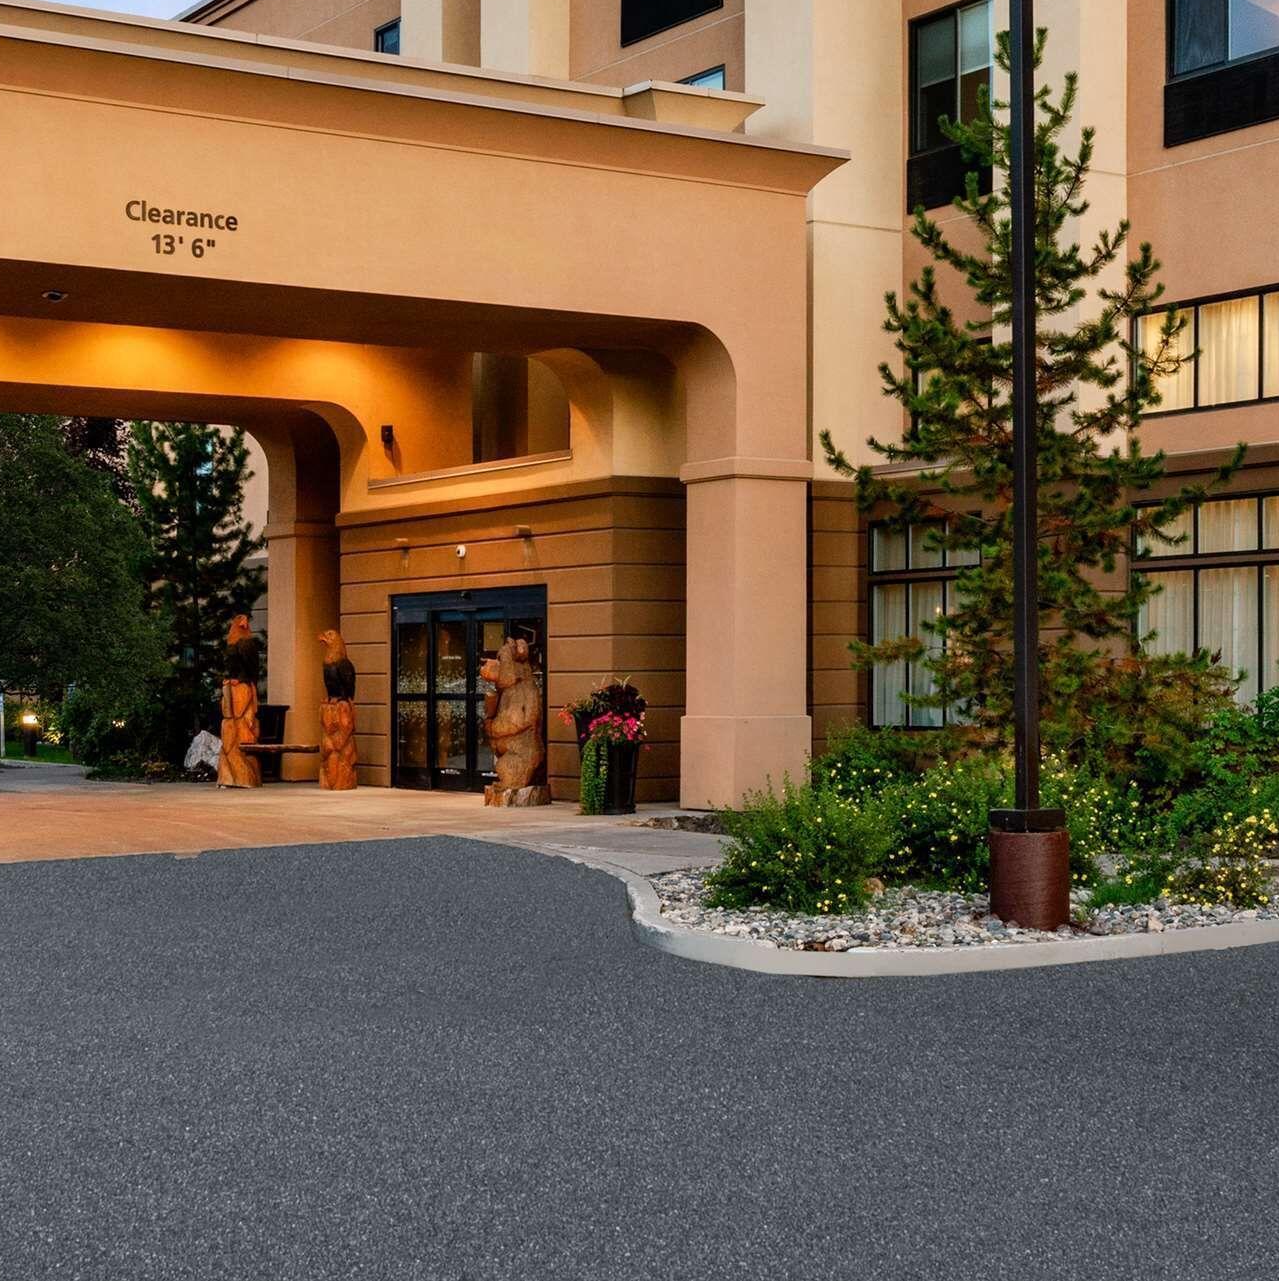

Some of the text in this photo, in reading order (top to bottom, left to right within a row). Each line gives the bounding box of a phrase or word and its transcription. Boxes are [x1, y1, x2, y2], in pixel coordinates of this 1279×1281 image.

[125, 200, 238, 231] Clearance
[151, 233, 216, 259] 13' 6"
